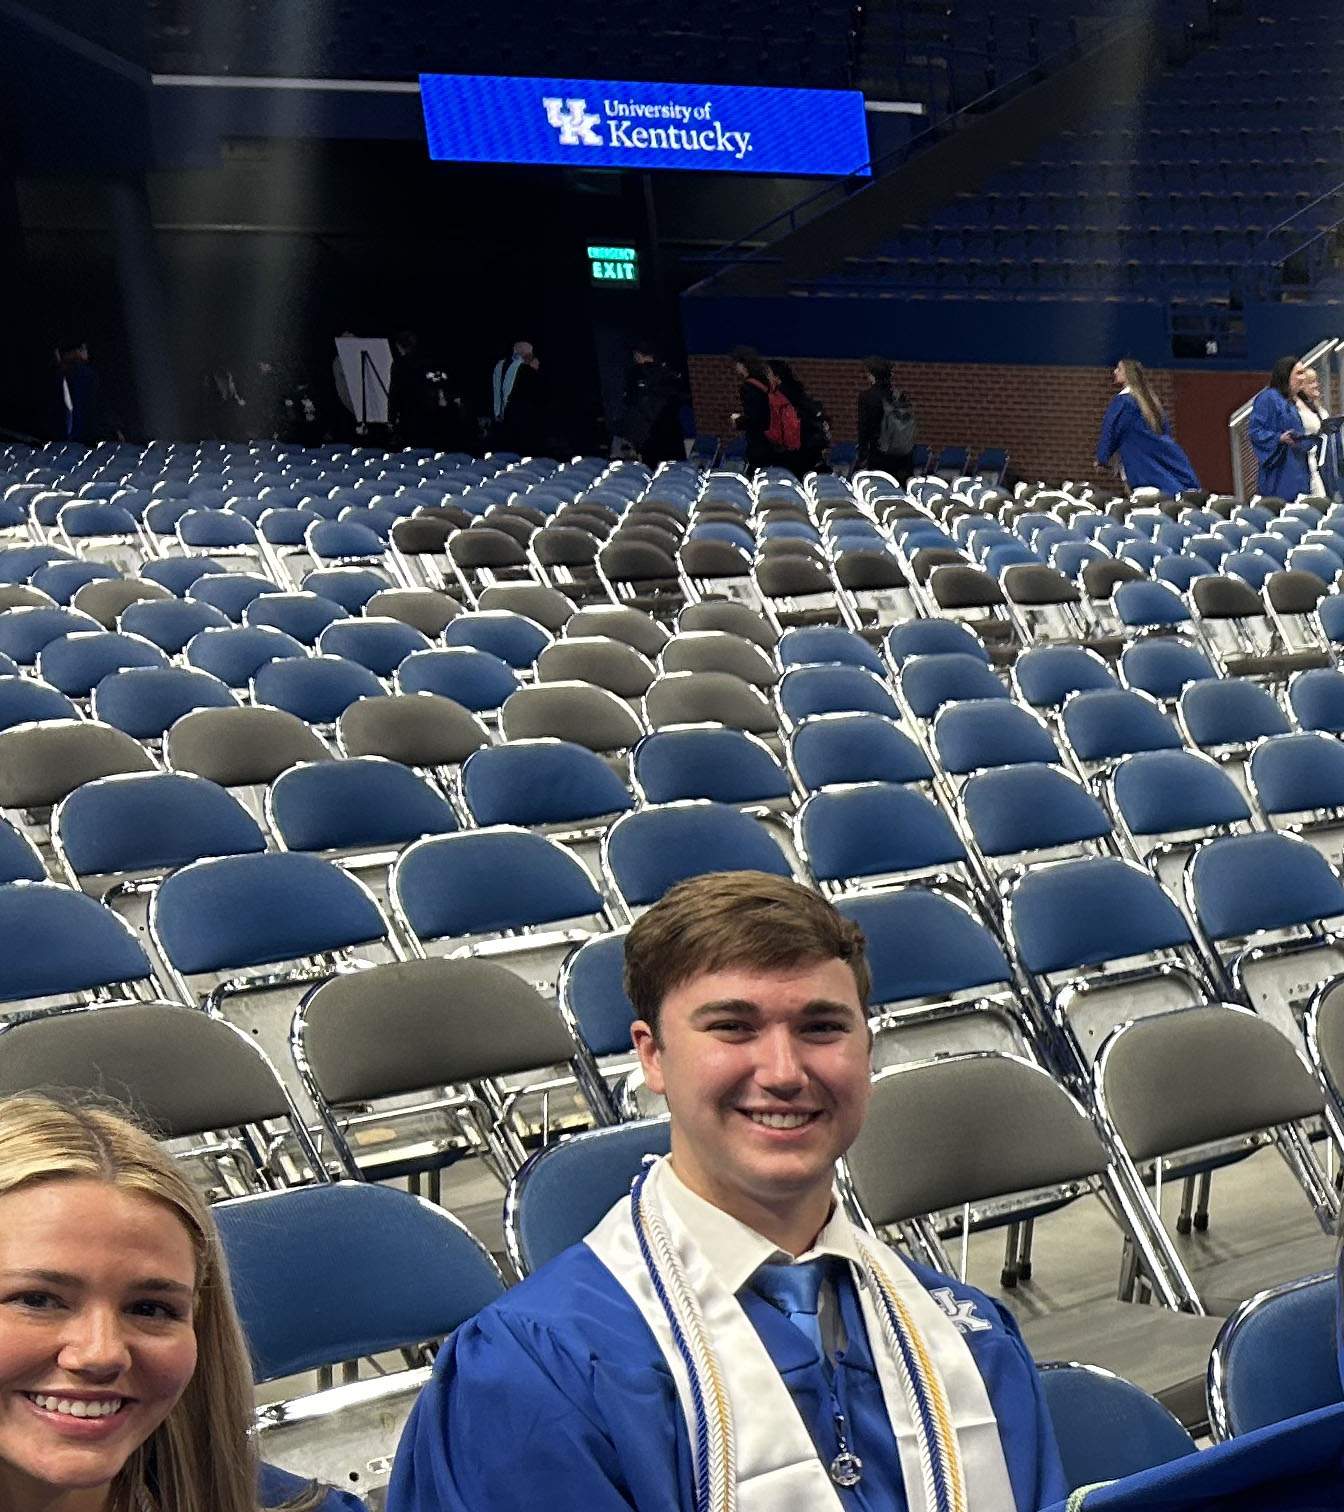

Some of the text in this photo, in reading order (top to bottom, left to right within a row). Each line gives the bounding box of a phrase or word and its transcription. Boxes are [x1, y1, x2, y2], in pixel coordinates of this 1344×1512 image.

[543, 97, 603, 145] UK
[604, 99, 712, 123] University of
[606, 120, 753, 159] Kentucky.
[592, 261, 634, 280] EXIT
